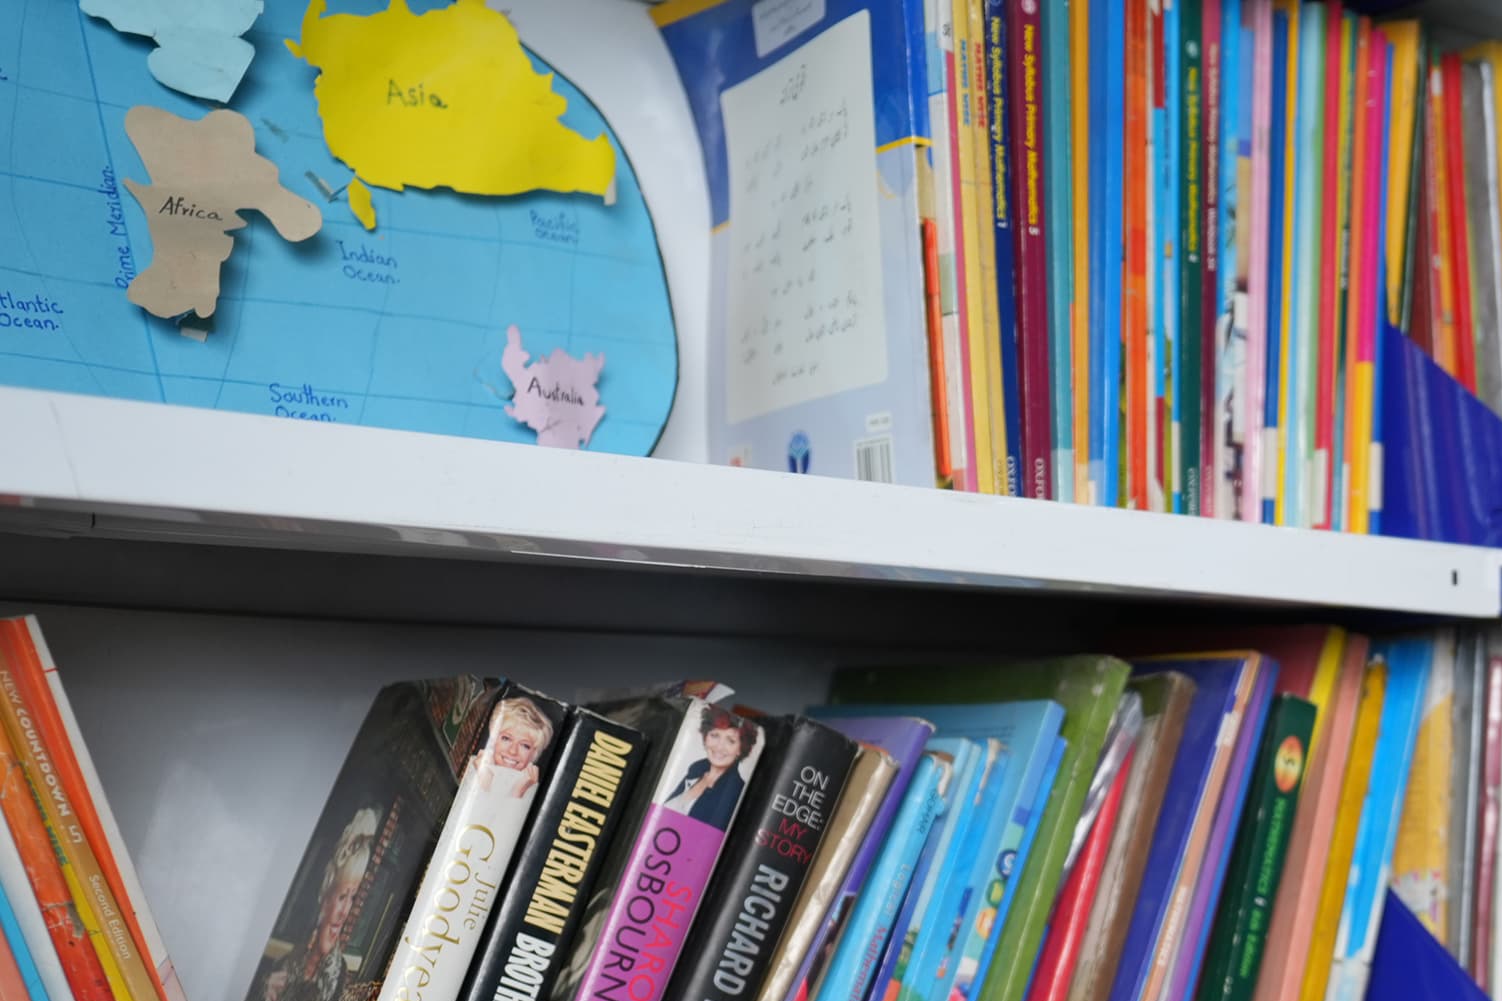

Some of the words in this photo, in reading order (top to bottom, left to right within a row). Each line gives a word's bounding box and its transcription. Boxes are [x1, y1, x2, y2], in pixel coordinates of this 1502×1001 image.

[991, 16, 1000, 44] New
[1023, 24, 1034, 51] New
[991, 46, 1002, 95] Syllabus
[1022, 53, 1036, 102] Syllabus
[386, 79, 449, 109] Asia
[1024, 104, 1037, 149] Primary
[995, 144, 1007, 219] Mathematics
[1026, 150, 1039, 225] Mathematics
[158, 196, 224, 221] Africa
[336, 240, 397, 268] Indian
[0, 292, 63, 314] tlantic
[269, 383, 348, 409] Southern
[527, 376, 584, 406] Australia
[1007, 455, 1017, 497] OXFO
[1035, 457, 1044, 498] OXFO
[571, 730, 634, 809] DANIEL
[800, 765, 829, 791] ON
[770, 793, 825, 832] EDGE:
[792, 779, 825, 809] THE
[0, 670, 21, 705] NEW
[15, 707, 71, 818] COUNTDOWN
[69, 824, 84, 844] 5
[88, 873, 114, 917] Second
[107, 918, 132, 960] Edition
[778, 818, 807, 840] MY
[754, 829, 813, 865] STORY
[1256, 797, 1288, 896] MATHEMATICS
[523, 801, 608, 936] EASTERMAN
[463, 872, 497, 931] Julie
[712, 863, 790, 996] RICHARD
